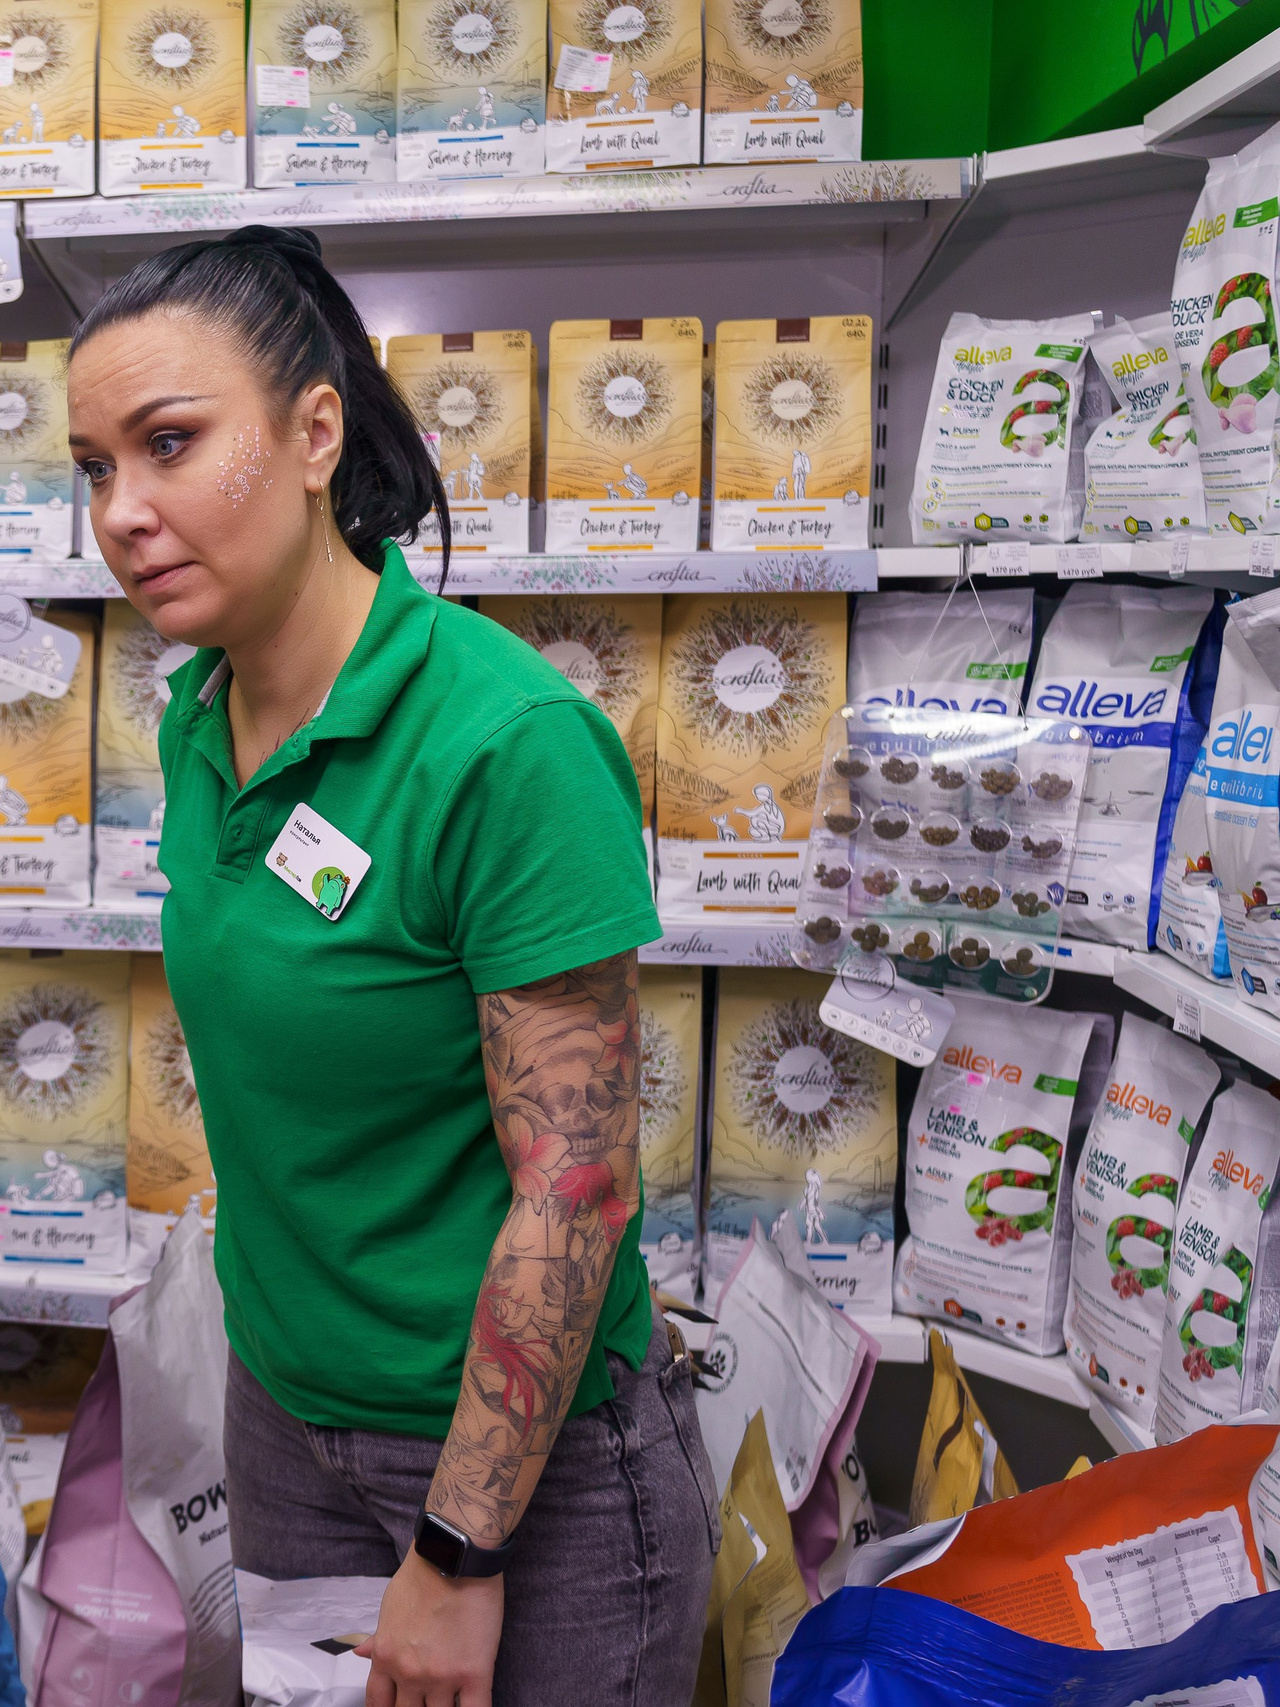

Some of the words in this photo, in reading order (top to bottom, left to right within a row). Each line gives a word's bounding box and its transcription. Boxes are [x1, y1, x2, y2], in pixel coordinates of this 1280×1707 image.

[580, 133, 602, 153] Lamb
[606, 132, 627, 151] with
[631, 130, 661, 150] Quail
[744, 131, 767, 150] Lamb
[771, 130, 791, 149] with
[795, 129, 825, 149] Quail
[285, 153, 317, 173] Salmon
[331, 153, 371, 175] Herring
[428, 149, 459, 170] Salmon
[474, 147, 516, 168] Herring
[707, 171, 792, 204] craftia
[1183, 213, 1227, 249] alleva
[1172, 310, 1208, 327] DUCK
[1185, 328, 1204, 340] VERA
[954, 345, 1013, 366] alleva
[1111, 346, 1169, 377] alleva
[946, 389, 955, 400] &
[959, 390, 995, 403] DUCK
[949, 377, 1004, 392] CHICKEN
[1126, 381, 1169, 402] CHICKEN
[1246, 444, 1270, 454] COMPLE
[465, 518, 493, 534] Quail
[580, 518, 615, 538] Chicken
[628, 517, 662, 539] Turkey
[747, 517, 784, 538] Chicken
[797, 517, 832, 540] Turkey
[631, 559, 718, 591] craftia
[718, 658, 780, 694] craftia
[1036, 680, 1169, 720] alleva
[1210, 779, 1264, 801] equilibriu
[293, 819, 322, 846] Наталья
[11, 853, 55, 881] Turkey
[697, 871, 727, 894] Lamb
[733, 872, 761, 892] with
[768, 870, 802, 894] Quai
[645, 927, 729, 962] craftia
[779, 1058, 840, 1092] craftia
[943, 1044, 1023, 1086] alleva
[1106, 1081, 1172, 1127] alleva
[928, 1107, 966, 1127] LAMB
[969, 1119, 979, 1132] &
[927, 1118, 987, 1148] VENISON
[1088, 1145, 1118, 1171] LAMB
[1117, 1161, 1127, 1175] &
[926, 1166, 954, 1182] ADULT
[1086, 1156, 1128, 1191] VENISON
[1212, 1149, 1265, 1197] alleva
[1185, 1215, 1214, 1246] LAMB
[1211, 1235, 1221, 1251] &
[1179, 1227, 1219, 1268] VENISON
[812, 1271, 859, 1297] erring
[170, 1479, 228, 1536] BOW
[1174, 1529, 1192, 1541] Amount
[1195, 1525, 1209, 1537] grams
[1133, 1546, 1144, 1559] Dog
[1105, 1569, 1113, 1579] kg
